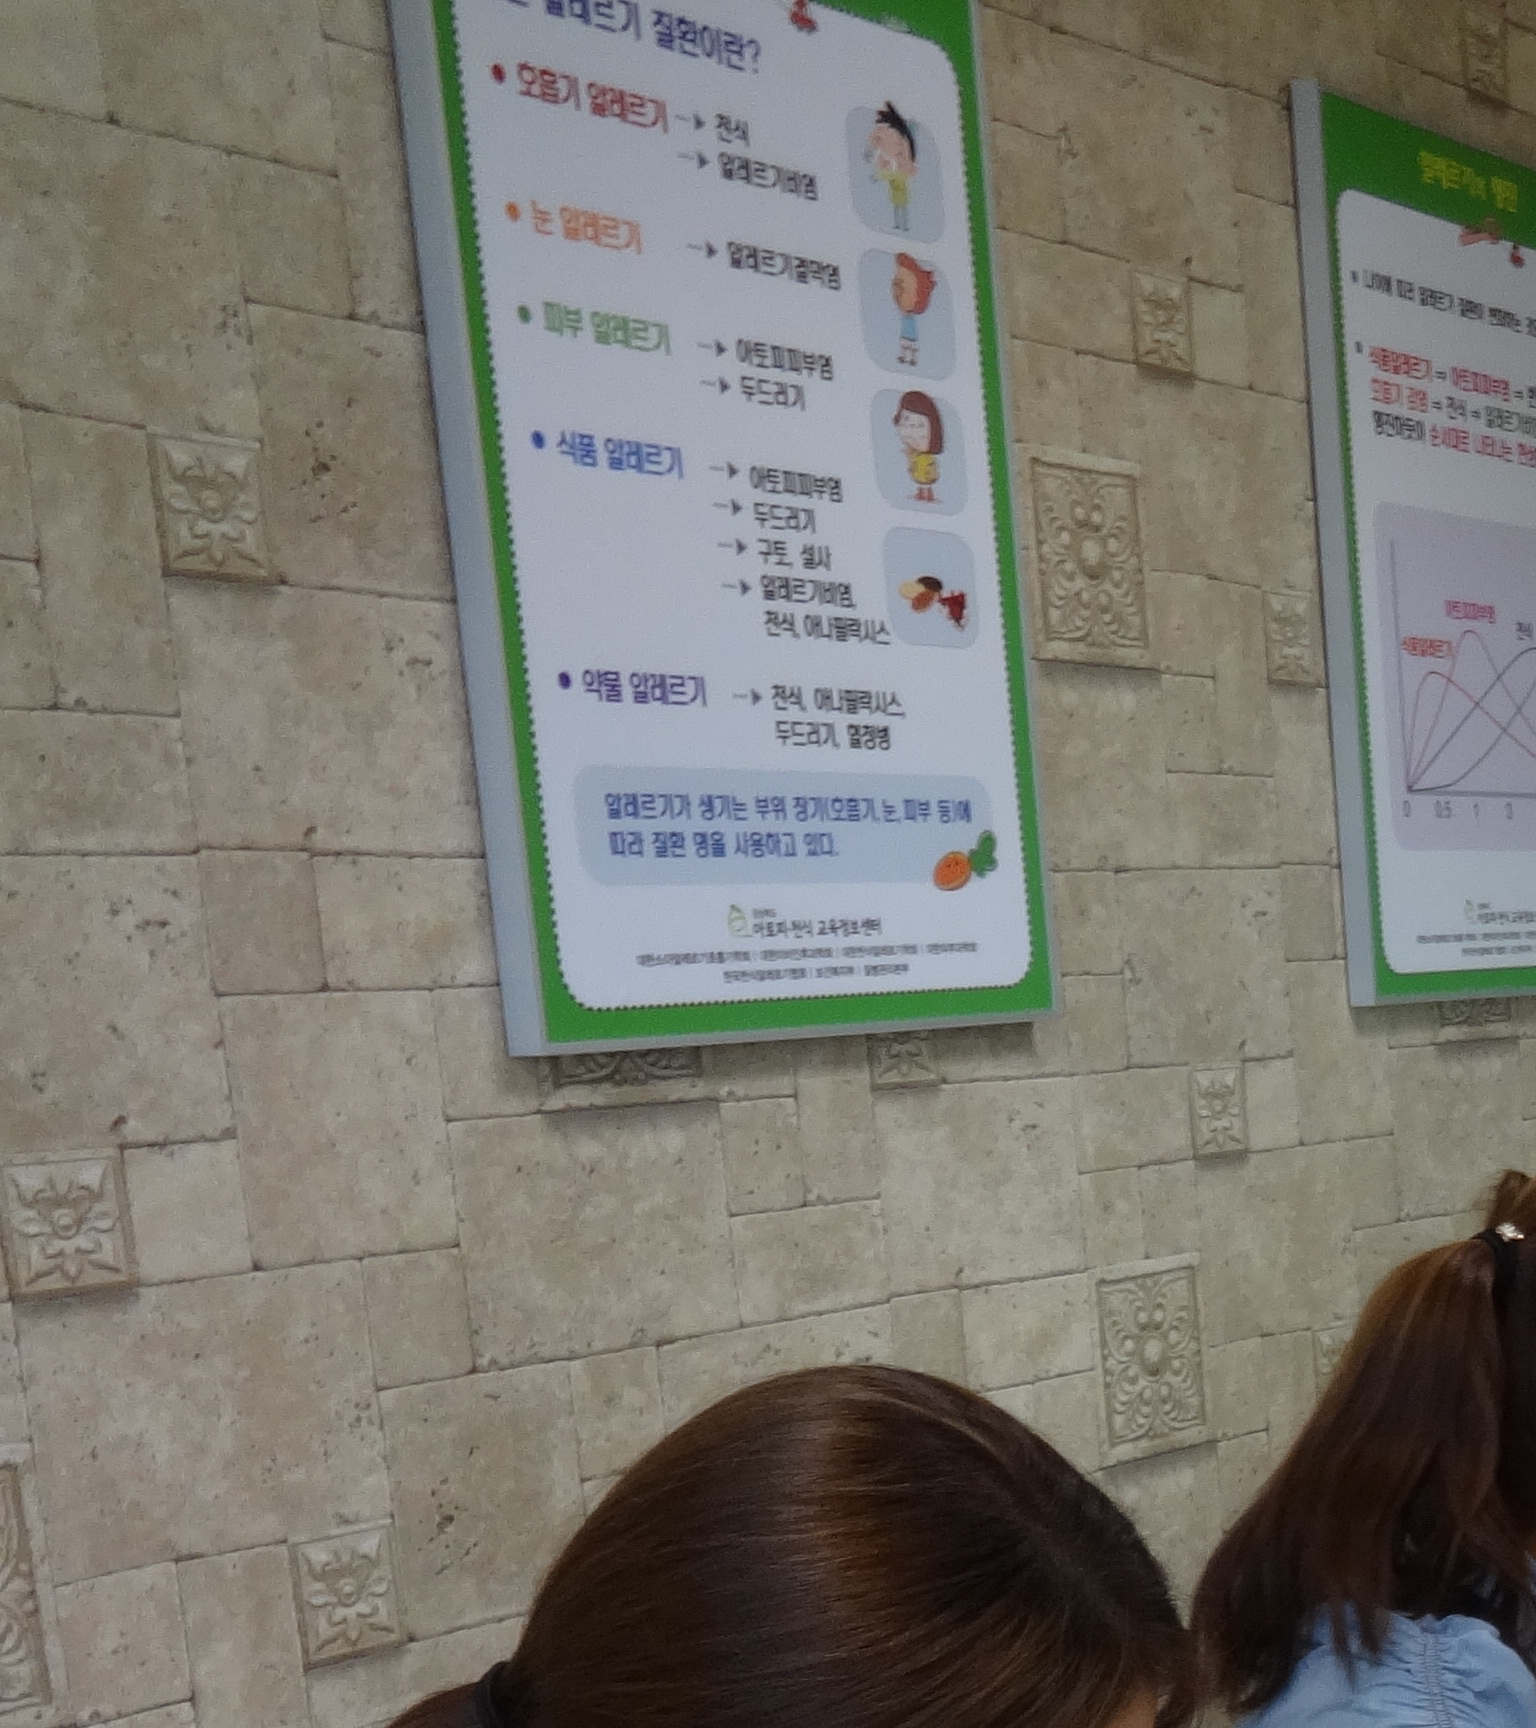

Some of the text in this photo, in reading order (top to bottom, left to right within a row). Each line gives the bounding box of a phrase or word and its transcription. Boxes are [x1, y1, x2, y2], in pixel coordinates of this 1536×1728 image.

[651, 9, 761, 73] 질환이란?
[516, 61, 750, 147] 호흡기 알레르기 천식
[717, 151, 818, 202] 알레르기비염
[530, 199, 841, 291] 눈 알레르기 알레르기결막염
[542, 300, 834, 381] 피부 알레르기 아토피피부염
[740, 375, 806, 411] 두드러기
[556, 430, 843, 503] 식품 알레르기 아토피피부염
[753, 501, 817, 534] 두드러기
[801, 543, 831, 571] 설사
[803, 613, 892, 646] 아나필락시스
[582, 668, 622, 703] 약물
[629, 671, 708, 708] 알레르기
[603, 792, 691, 822] 알레르기가
[698, 794, 749, 822] 생기는
[754, 795, 787, 822] 부위
[608, 831, 840, 859] 따라 질환 명을 사용하고 있다.
